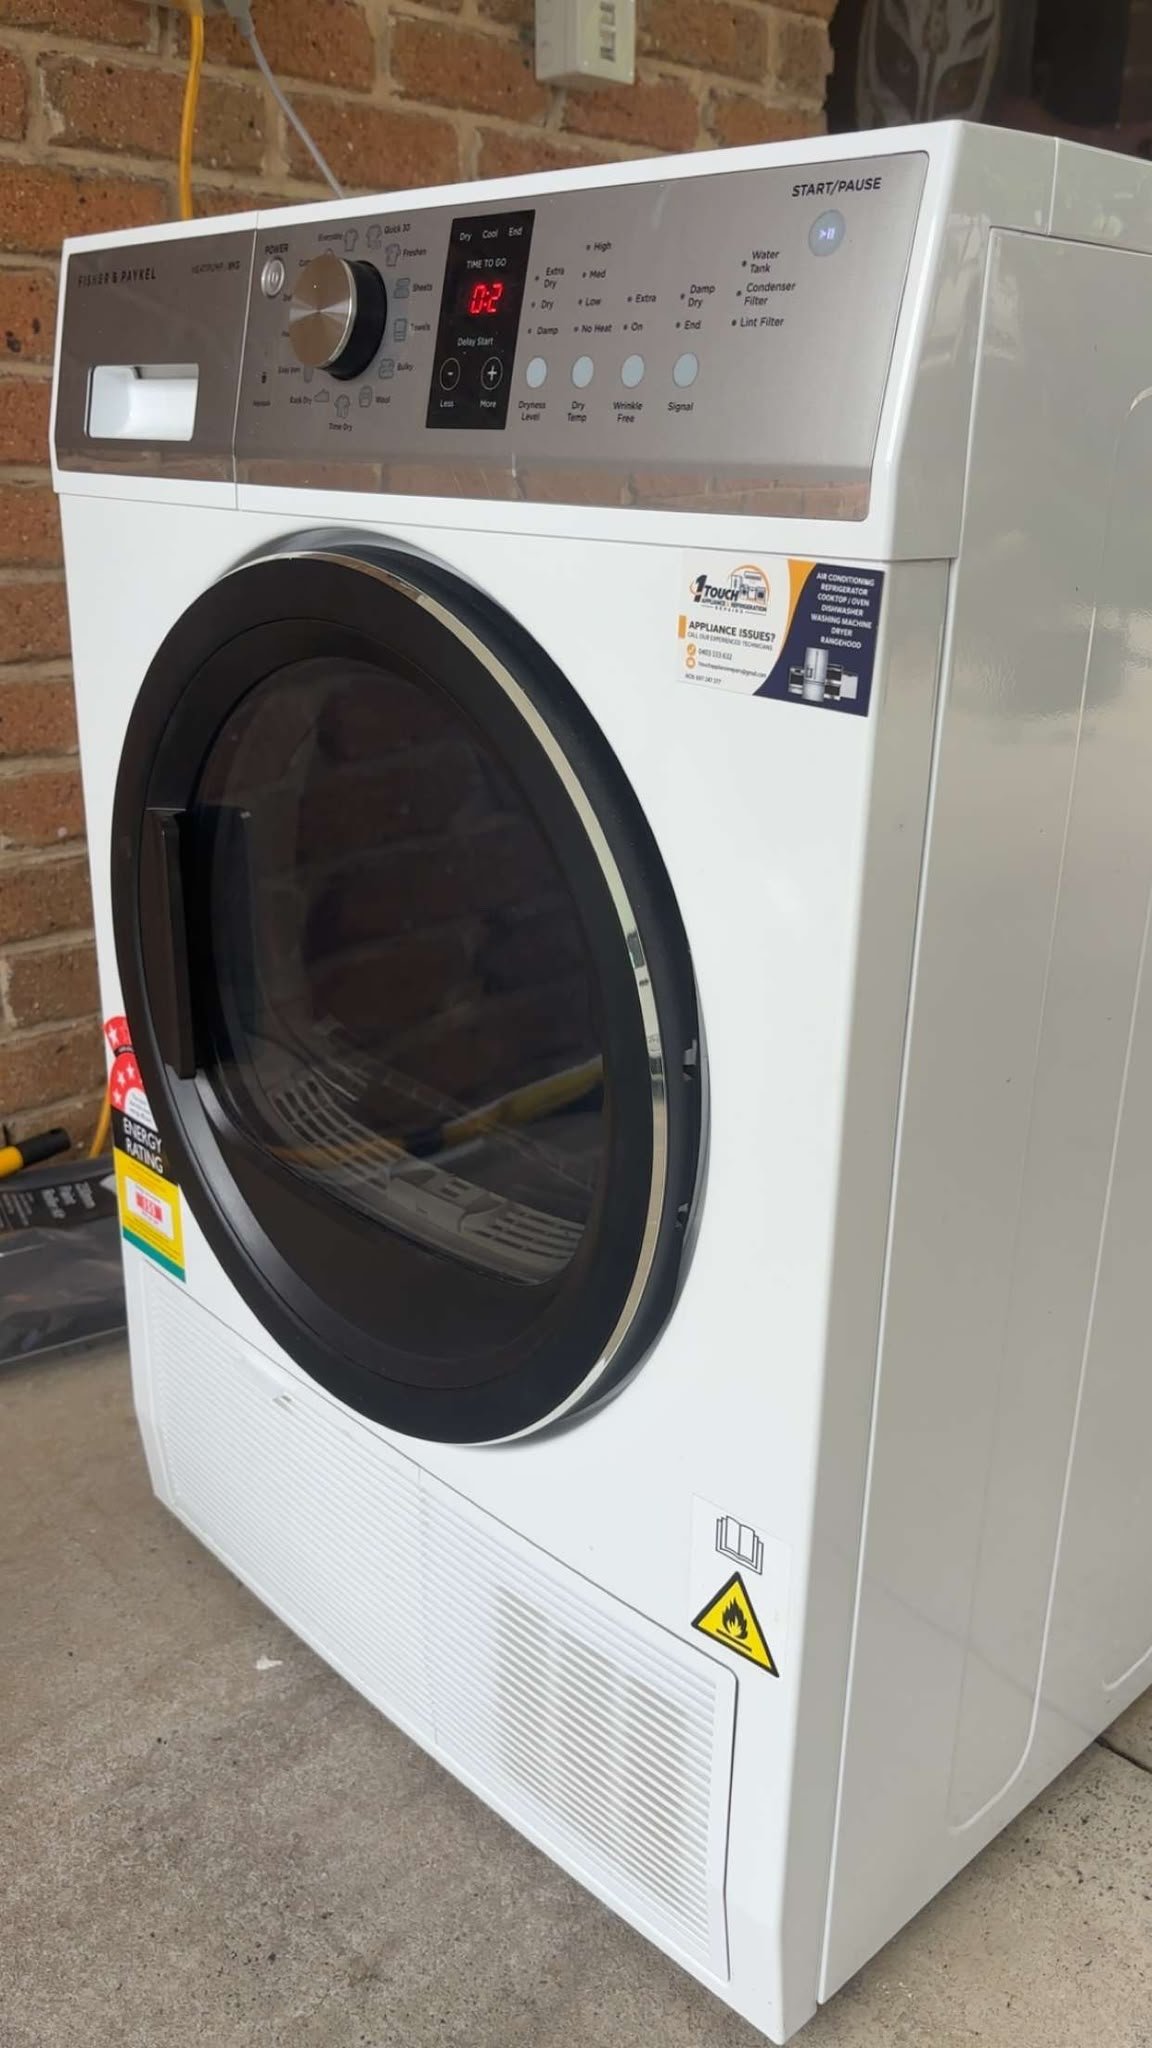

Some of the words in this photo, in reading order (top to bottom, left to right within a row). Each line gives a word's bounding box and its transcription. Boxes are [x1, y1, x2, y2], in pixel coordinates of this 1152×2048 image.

[791, 177, 882, 197] START/PAUSE
[384, 225, 401, 235] Quick
[482, 229, 498, 239] Cool
[508, 227, 523, 237] End
[459, 231, 472, 242] Dry
[264, 243, 289, 255] POWER
[594, 241, 612, 252] High
[402, 248, 427, 257] Freshen
[752, 250, 780, 260] Water
[467, 259, 483, 268] TIME
[483, 259, 494, 267] TO
[495, 258, 507, 267] GO
[750, 263, 771, 274] Tank
[78, 273, 109, 288] FISHER
[112, 272, 118, 283] &
[120, 267, 156, 283] PAYKEL
[546, 267, 565, 277] Extra
[590, 270, 607, 279] Med
[412, 283, 433, 292] Sheets
[544, 279, 557, 290] Dry
[690, 285, 715, 295] Damp
[746, 282, 796, 293] Condenser
[585, 297, 601, 306] Low
[635, 294, 657, 304] Extra
[688, 297, 703, 308] Dry
[744, 296, 768, 306] Filter
[541, 300, 554, 311] Dry
[631, 322, 643, 332] On
[684, 320, 701, 330] End
[740, 317, 758, 328] Lint
[760, 317, 784, 327] Filter
[537, 326, 559, 336] Damp
[581, 324, 593, 334] No
[594, 323, 612, 333] Heat
[457, 337, 476, 348] Delay
[477, 337, 494, 347] Start
[440, 399, 455, 408] Less
[480, 399, 497, 408] More
[518, 400, 546, 411] Dryness
[571, 401, 585, 412] Dry
[613, 401, 643, 411] Wrinkle
[668, 401, 694, 412] Signal
[521, 412, 541, 422] Level
[567, 413, 587, 424] Temp
[617, 413, 635, 423] Free
[329, 422, 343, 431] Time
[343, 423, 353, 432] Dry
[816, 572, 827, 580] AIR
[828, 574, 875, 587] CONDITIONING
[704, 585, 740, 602] TOUCH
[820, 583, 868, 596] REFRIGERATOR
[817, 593, 847, 604] COOKTOP
[851, 598, 870, 607] OVEN
[821, 605, 864, 616] DISHWASHER
[811, 613, 841, 625] WASHING
[841, 618, 873, 630] MACHINE
[689, 620, 737, 637] APPLIANCE
[739, 628, 776, 643] ISSUES?
[830, 627, 853, 637] DRYER
[820, 636, 862, 649] RANGEHOOD
[123, 1118, 162, 1153] ENERGY
[125, 1137, 164, 1175] RATING
